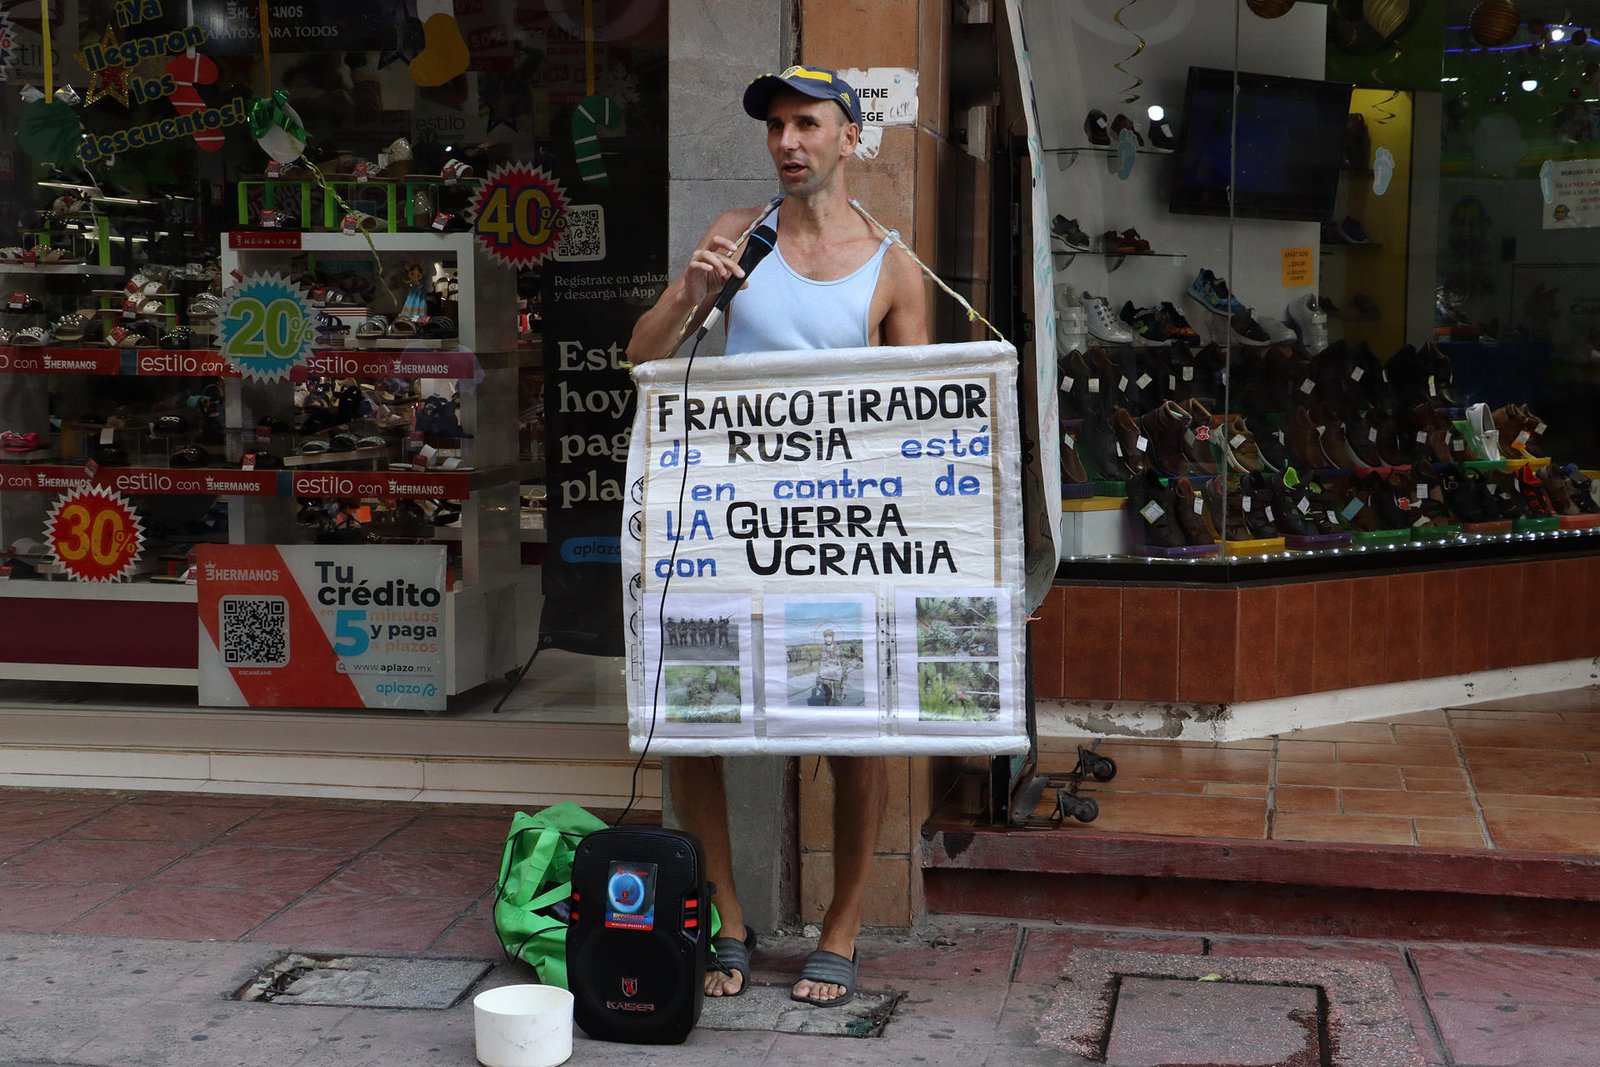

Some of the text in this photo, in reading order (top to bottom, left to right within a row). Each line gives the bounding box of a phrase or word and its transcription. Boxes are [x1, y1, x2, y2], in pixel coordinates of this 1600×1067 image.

[115, 0, 163, 28] ¡Ya
[294, 25, 339, 38] TODOS
[84, 25, 207, 72] llegaron
[131, 73, 177, 104] los
[856, 88, 888, 98] IENE
[80, 97, 247, 162] descuentos!
[478, 186, 567, 246] 40%
[554, 273, 613, 289] Regístrate
[616, 275, 630, 284] en
[554, 286, 656, 302] y descarga la App
[228, 299, 314, 359] 20%
[14, 359, 38, 369] con
[141, 354, 197, 372] estilo
[201, 361, 223, 372] con
[363, 363, 388, 374] con
[557, 381, 633, 419] hoy
[659, 439, 702, 468] de
[901, 425, 990, 459] está
[8, 477, 32, 486] con
[116, 473, 172, 491] estilo
[176, 480, 200, 491] con
[296, 476, 353, 494] estilo
[358, 483, 382, 494] con
[691, 463, 981, 502] en contra de
[667, 501, 908, 542] LA GUERRA
[58, 504, 137, 566] 30%
[315, 561, 353, 584] Tu
[655, 557, 716, 579] con
[318, 579, 441, 607] crédito
[334, 610, 369, 657] 5
[370, 610, 439, 623] minutos
[370, 625, 437, 641] y paga
[385, 642, 438, 653] plazos
[354, 663, 432, 673] www.aplazo.mx
[376, 682, 421, 696] aplazo
